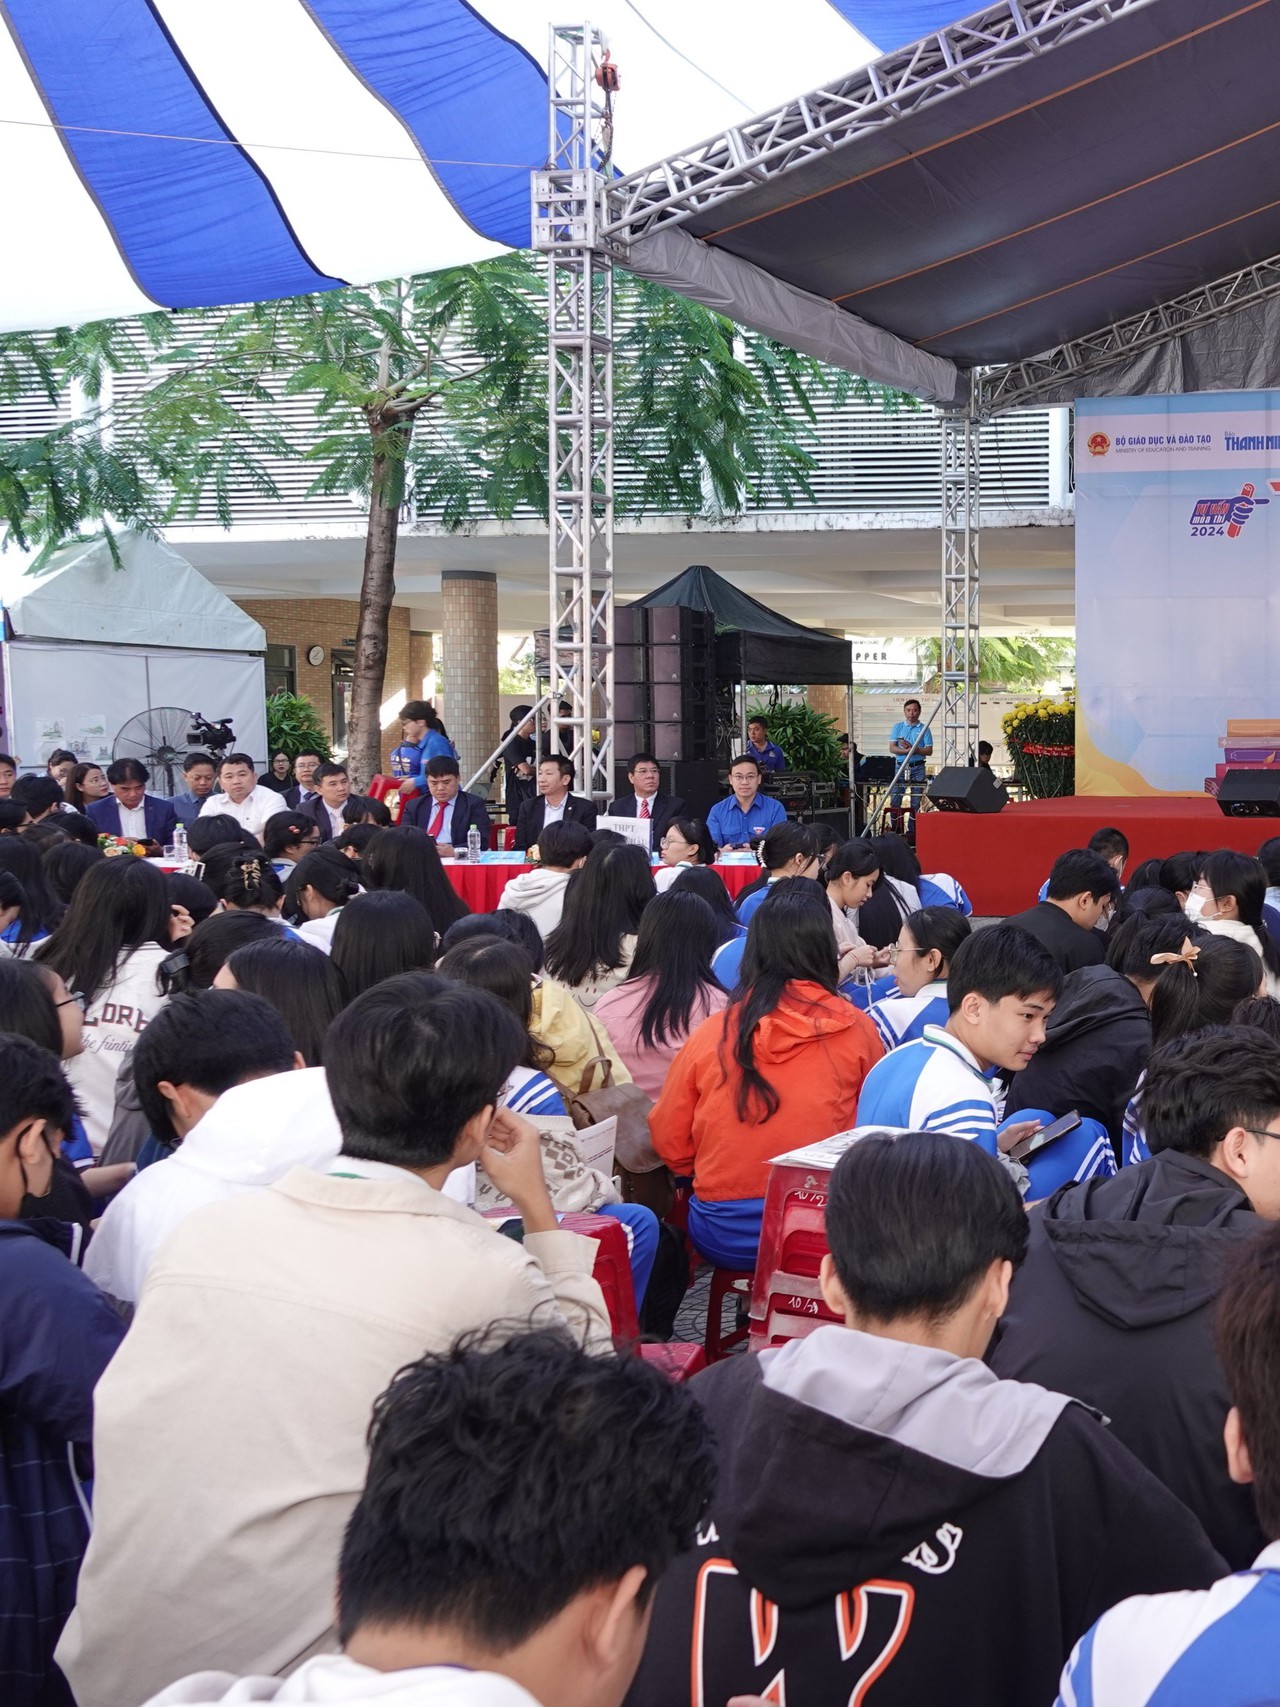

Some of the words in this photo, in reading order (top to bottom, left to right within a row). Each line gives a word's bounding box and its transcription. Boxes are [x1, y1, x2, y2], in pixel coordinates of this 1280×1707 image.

[1116, 435, 1126, 447] BỘ
[1128, 434, 1146, 445] GIÁO
[1148, 436, 1164, 447] DỤC
[1166, 434, 1177, 444] VÀ
[1178, 433, 1194, 444] ĐÀO
[1197, 434, 1211, 446] TẠO
[1225, 436, 1264, 451] THANH
[1191, 526, 1225, 536] 2024
[613, 824, 636, 832] THPT
